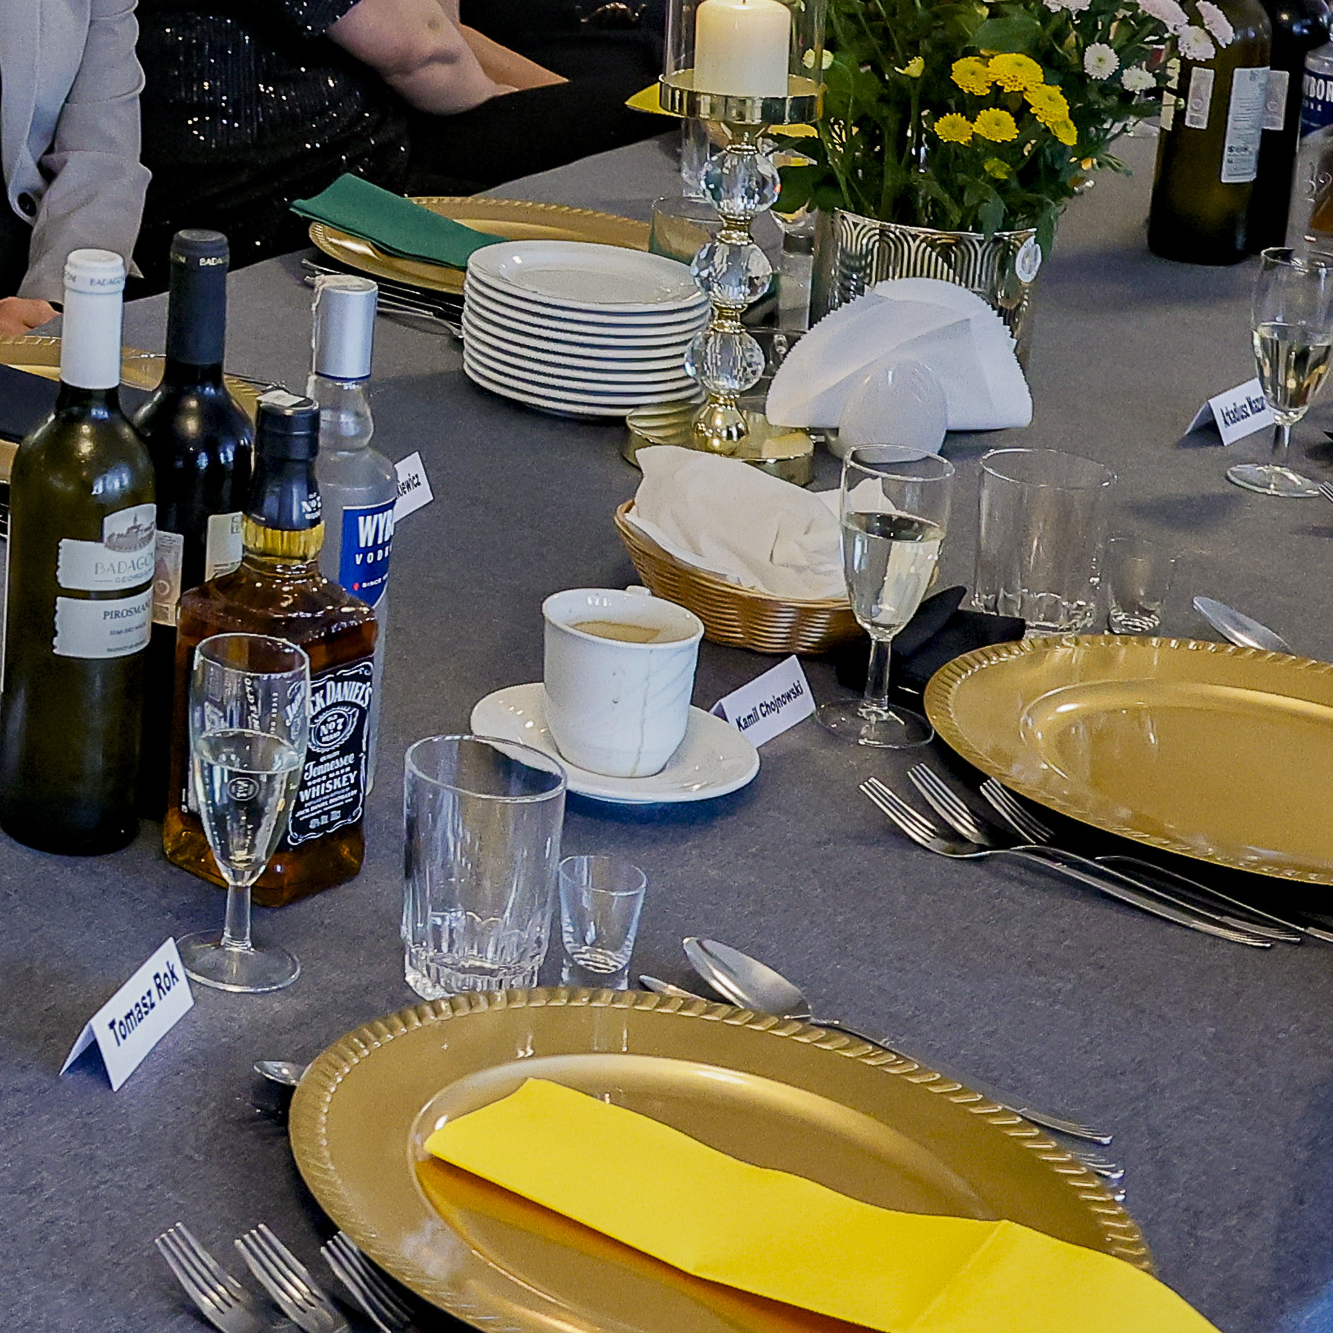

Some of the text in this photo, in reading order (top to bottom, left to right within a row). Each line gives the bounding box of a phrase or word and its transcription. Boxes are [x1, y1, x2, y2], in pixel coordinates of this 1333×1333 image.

[326, 680, 373, 708] DANIEL'S
[735, 680, 804, 732] Kamil Chojnowski
[304, 753, 355, 780] Tennessee
[299, 770, 358, 802] WHISKEY
[108, 960, 180, 1047] Tomasz Rok
